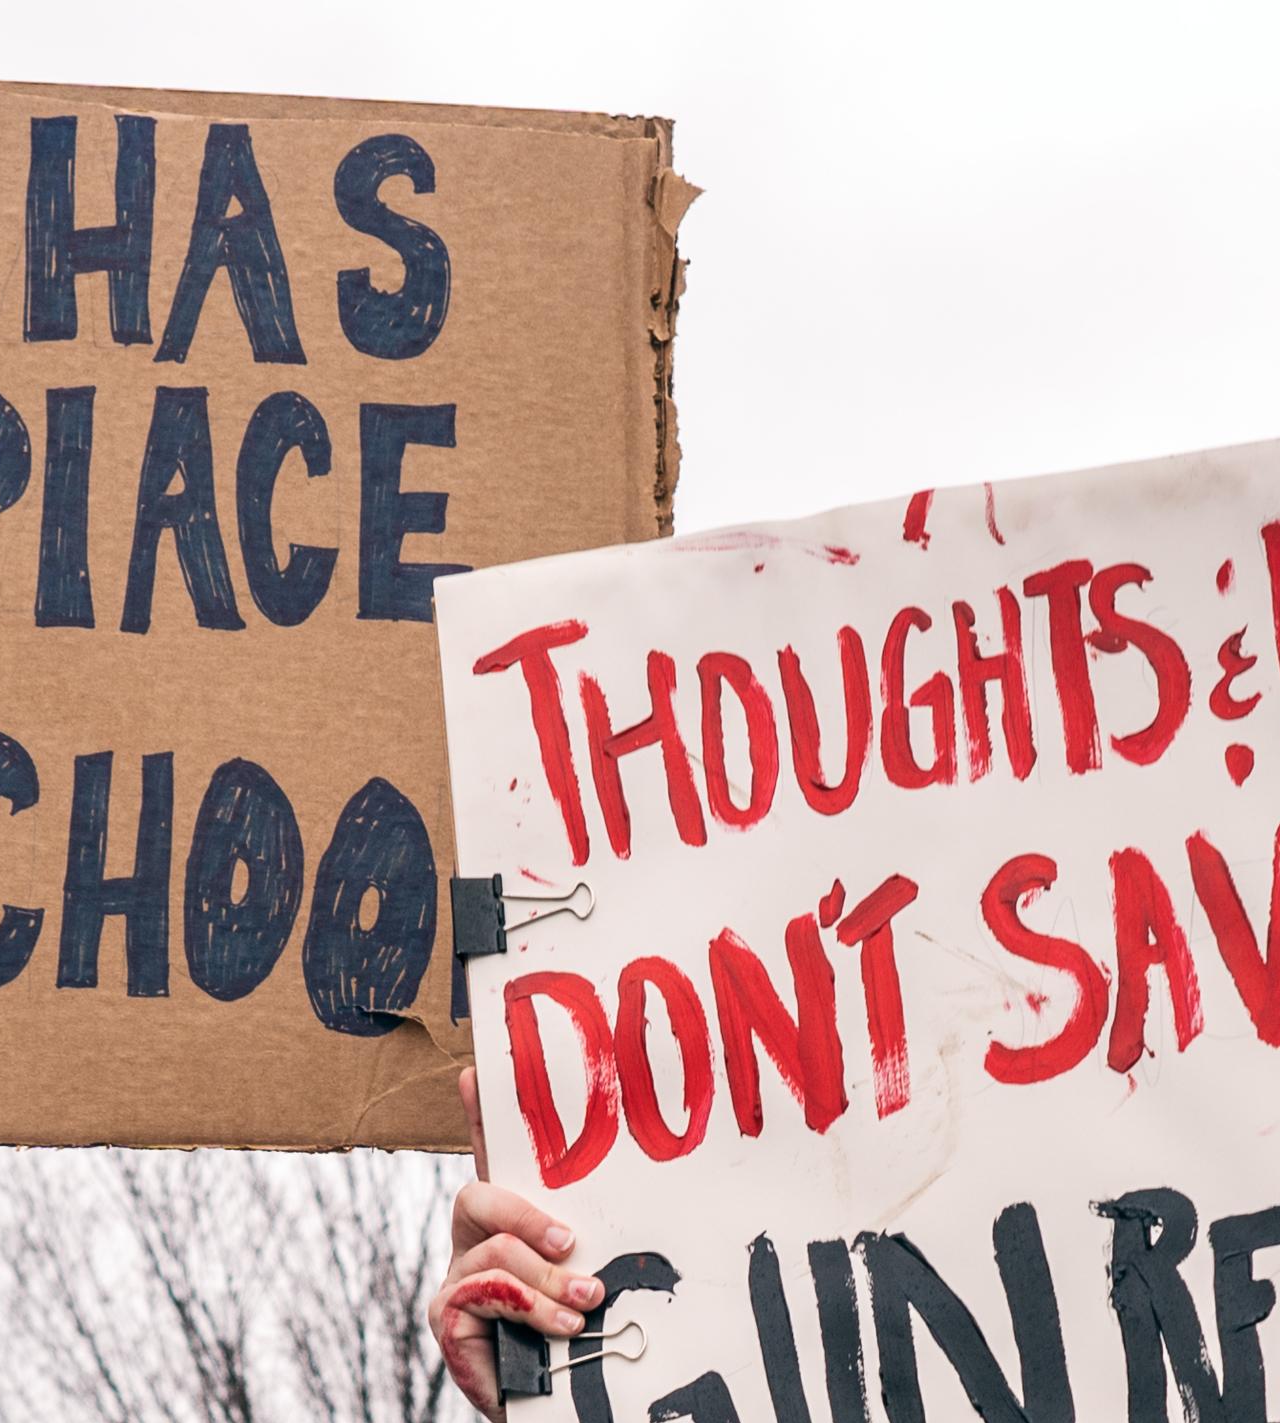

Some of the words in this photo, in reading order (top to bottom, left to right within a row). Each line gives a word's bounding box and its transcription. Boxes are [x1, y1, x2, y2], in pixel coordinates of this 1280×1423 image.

[23, 114, 452, 365] HAS
[473, 557, 1193, 867] THOUGHTS
[505, 873, 919, 1190] DON'T
